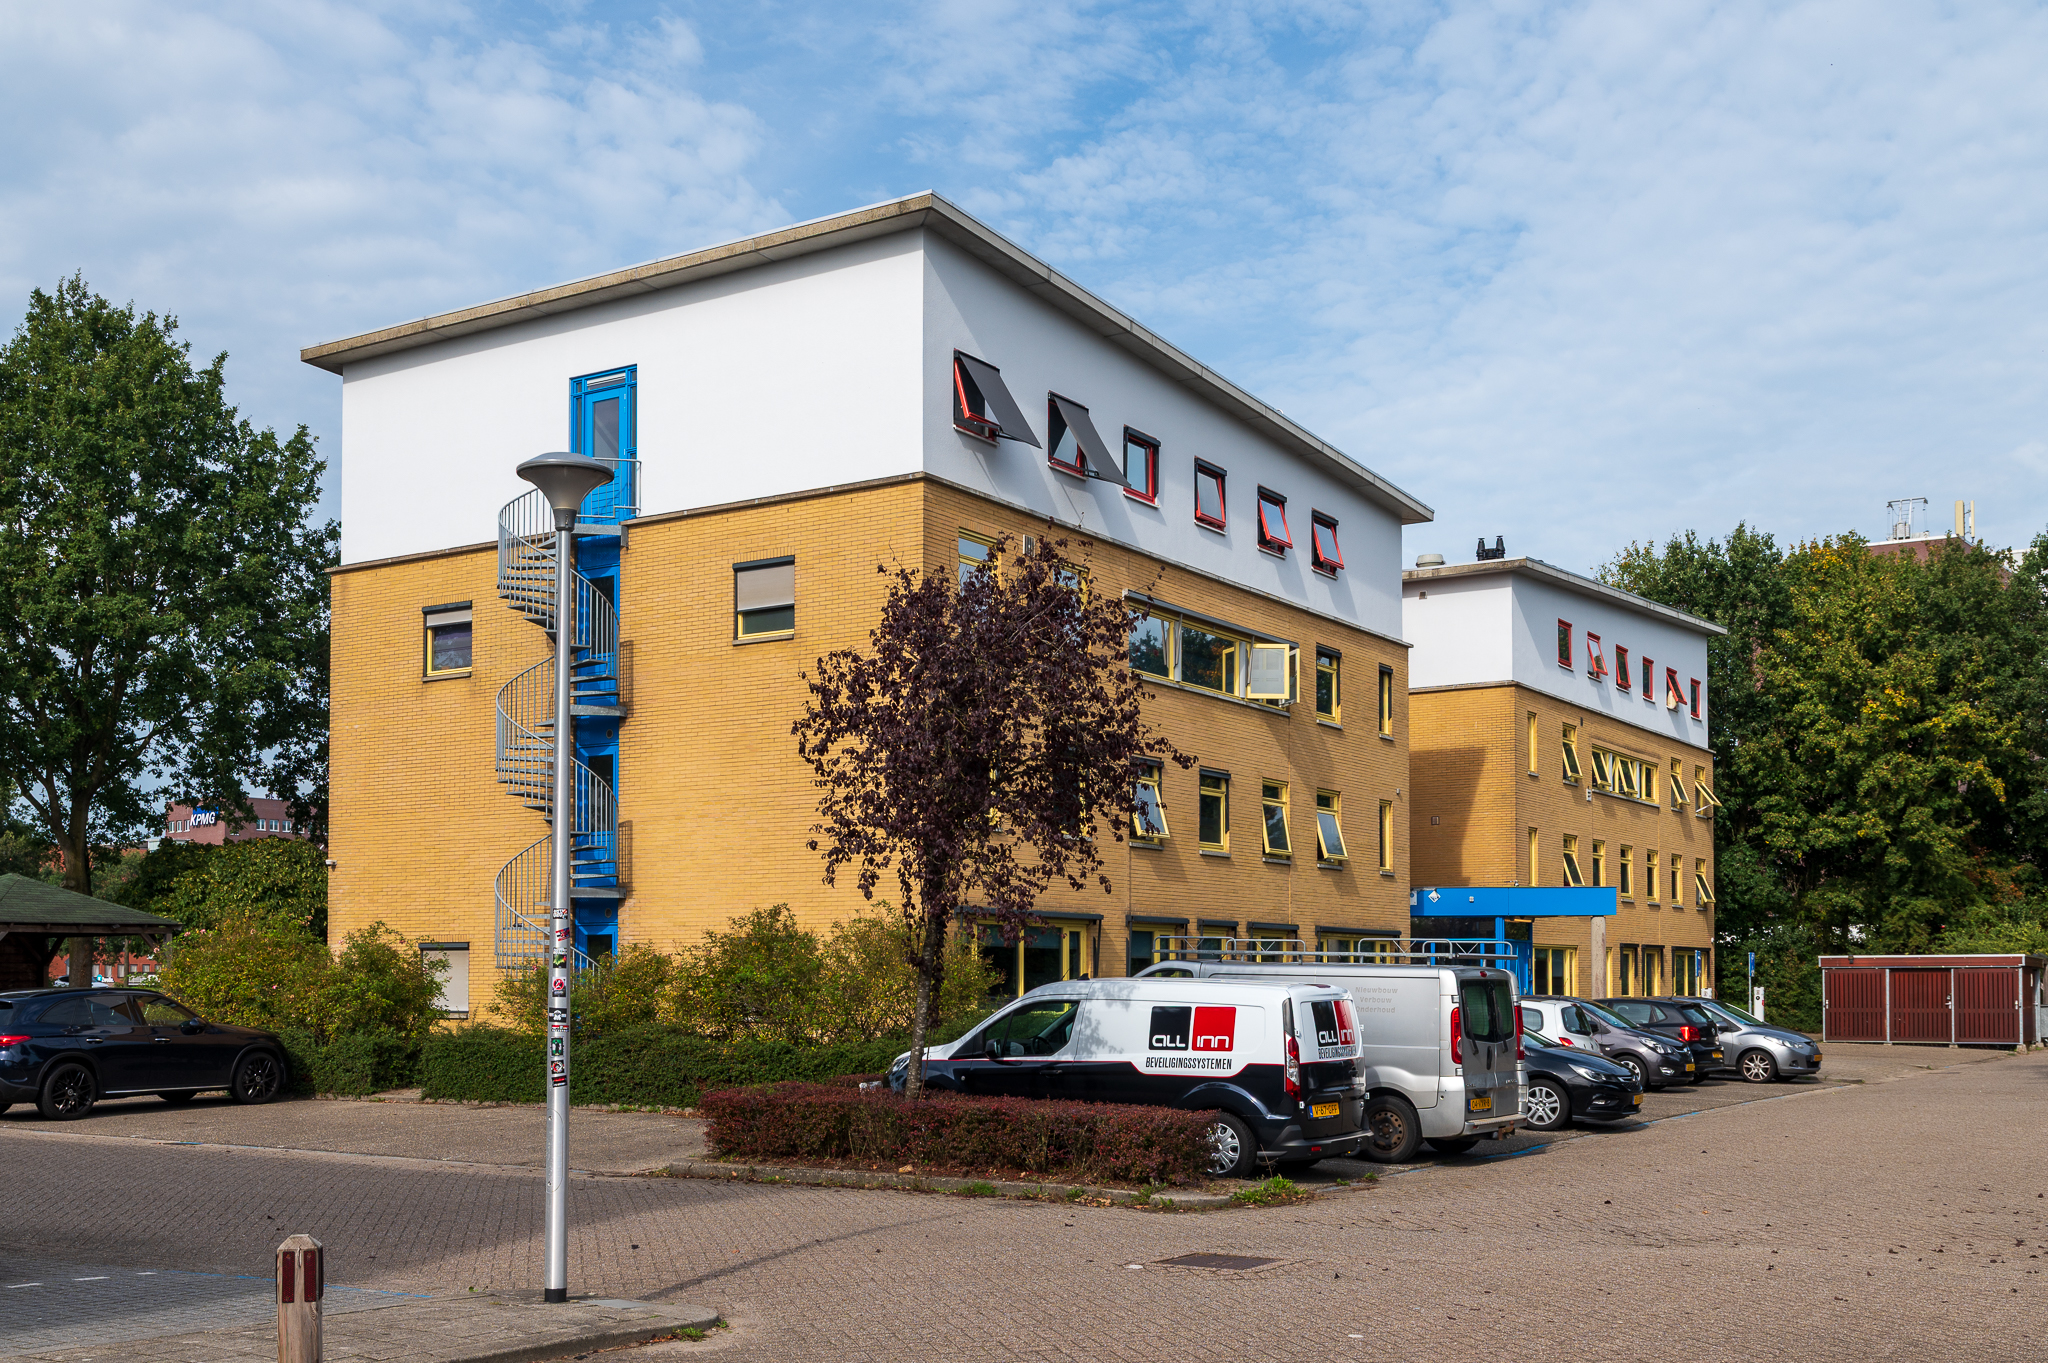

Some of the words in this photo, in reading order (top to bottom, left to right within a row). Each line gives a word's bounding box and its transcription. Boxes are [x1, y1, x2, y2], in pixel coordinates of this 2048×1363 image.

[190, 811, 216, 827] KPMG
[1355, 986, 1398, 994] Nieuwbouw
[1360, 996, 1392, 1004] Verbouw
[1356, 1005, 1395, 1013] Onderhoud
[1145, 1056, 1233, 1070] BEVEILIGINGSSYSTEMEN
